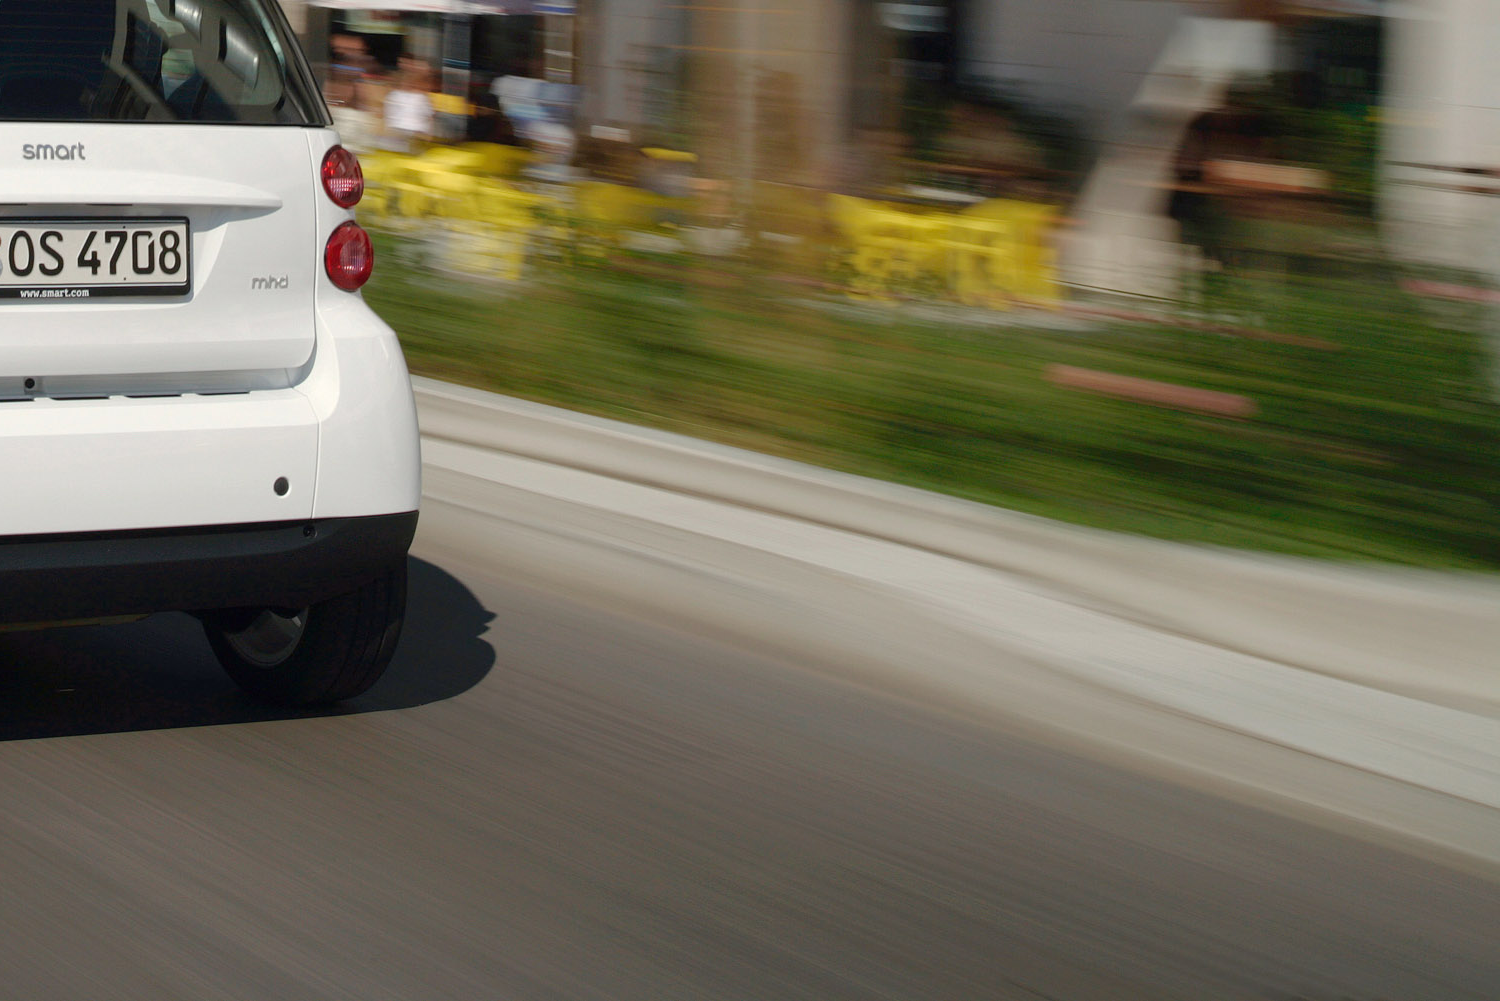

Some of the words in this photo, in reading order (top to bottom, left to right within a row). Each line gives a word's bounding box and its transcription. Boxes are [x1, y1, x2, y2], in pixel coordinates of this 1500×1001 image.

[22, 142, 86, 161] smart
[8, 230, 64, 277] OS
[77, 229, 182, 276] 4708
[251, 274, 289, 290] mhd
[19, 288, 90, 299] www.smart.com
